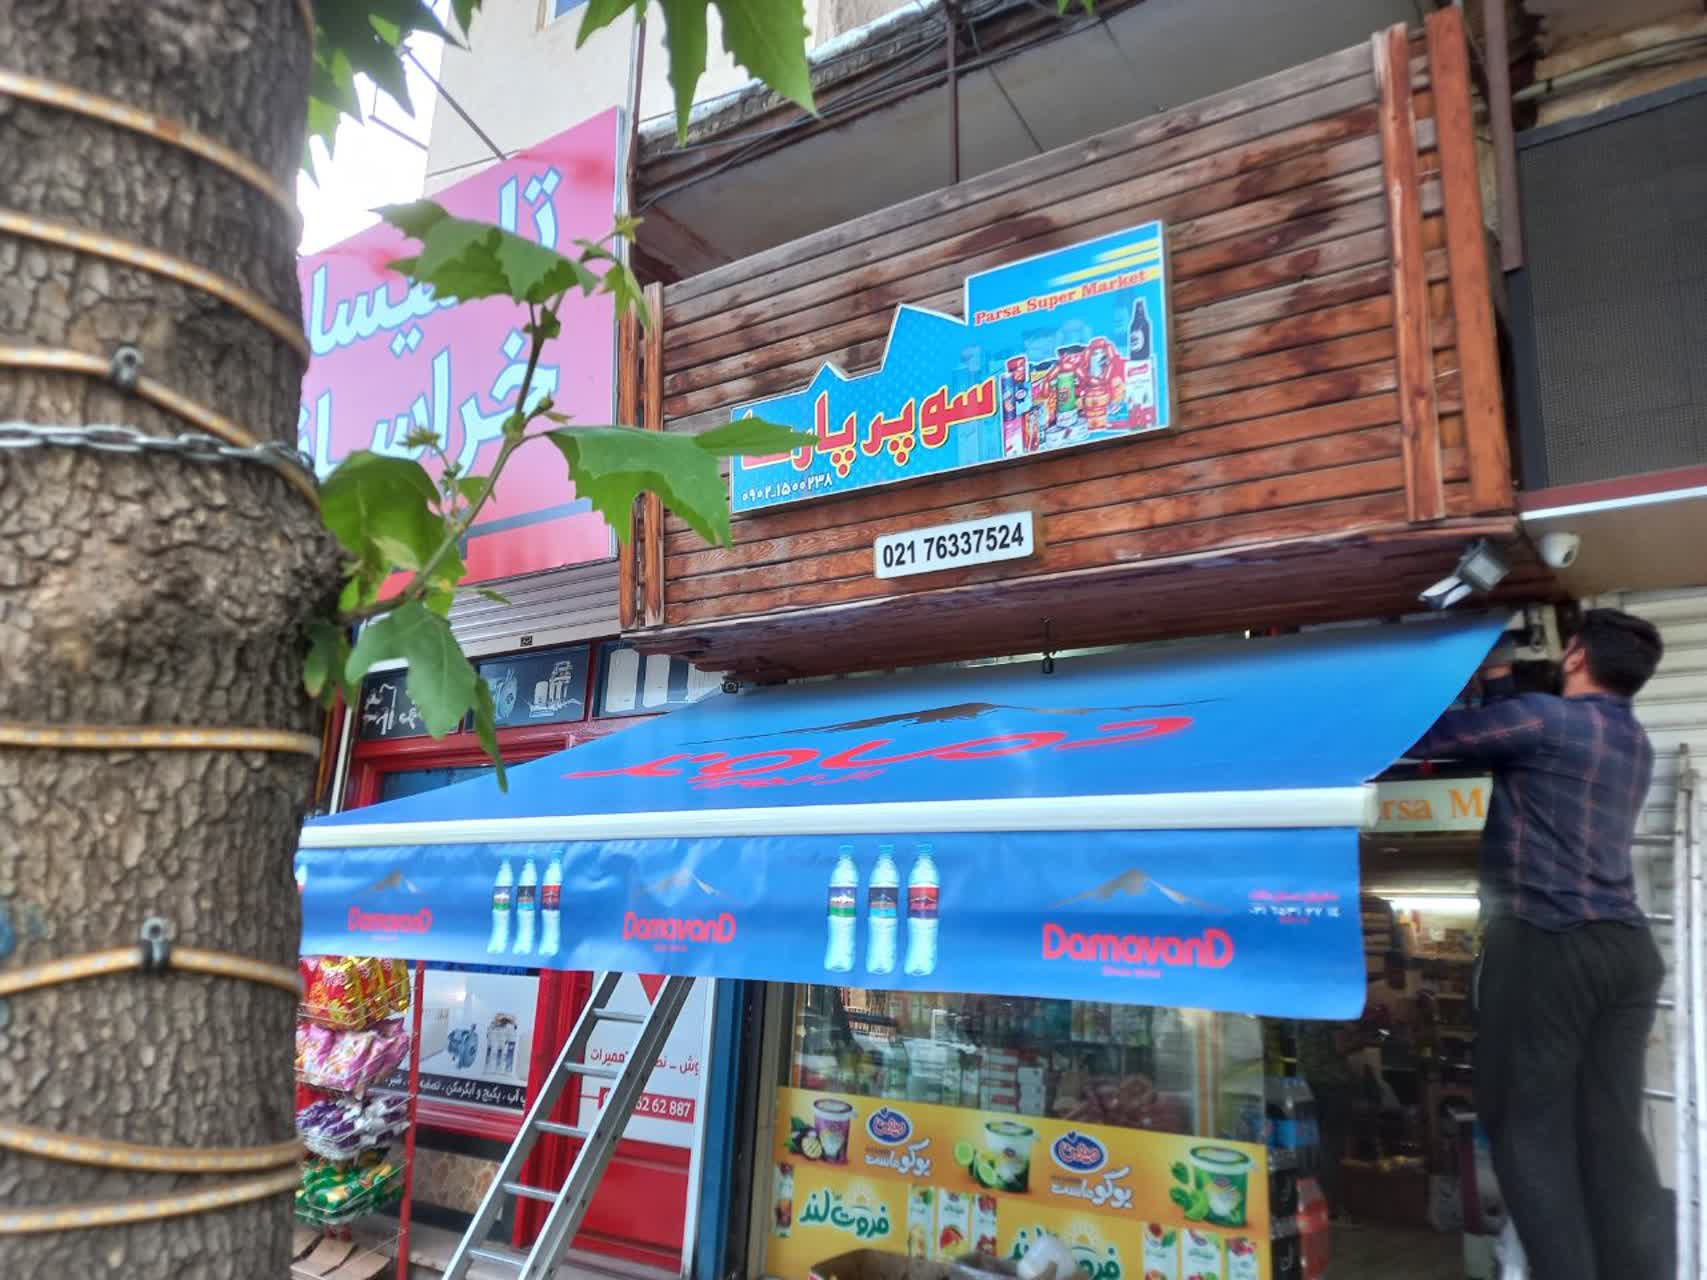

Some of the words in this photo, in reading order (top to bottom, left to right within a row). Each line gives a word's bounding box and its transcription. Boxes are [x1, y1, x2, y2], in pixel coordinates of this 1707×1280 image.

[975, 306, 1022, 326] Parsa
[1026, 290, 1076, 311] Super
[1081, 270, 1147, 298] Market
[861, 376, 998, 466] سوپر
[882, 540, 917, 569] 021
[924, 522, 1025, 562] 76337524
[651, 1097, 667, 1114] 62
[669, 1100, 692, 1118] 887
